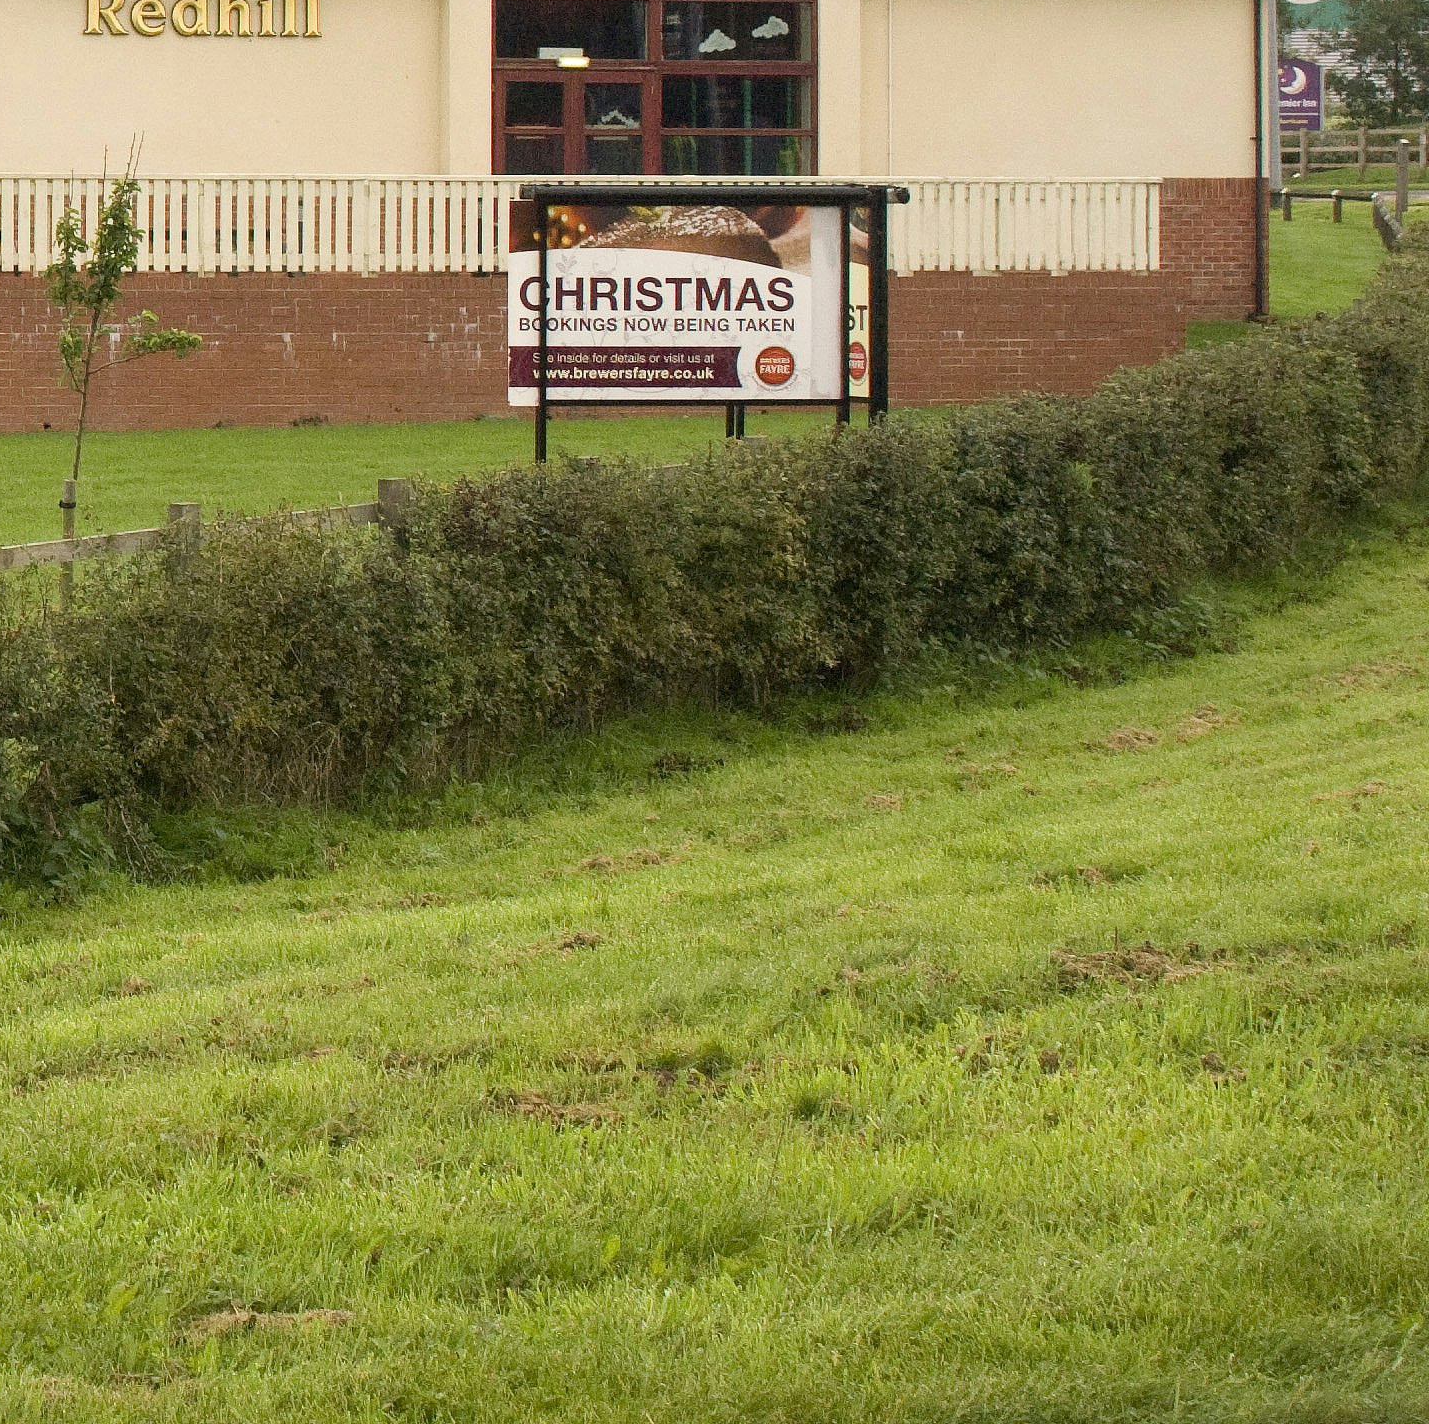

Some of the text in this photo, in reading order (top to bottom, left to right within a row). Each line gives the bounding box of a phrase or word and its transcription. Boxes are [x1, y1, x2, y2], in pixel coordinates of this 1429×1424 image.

[519, 276, 795, 312] CHRISTMAS
[519, 317, 796, 332] BOOKINGS NOW BEING TAKEN
[532, 352, 554, 364] Se
[592, 352, 608, 364] for
[610, 352, 646, 364] details
[648, 354, 661, 364] or
[663, 353, 685, 364] visit
[687, 355, 701, 364] us
[703, 353, 715, 364] at
